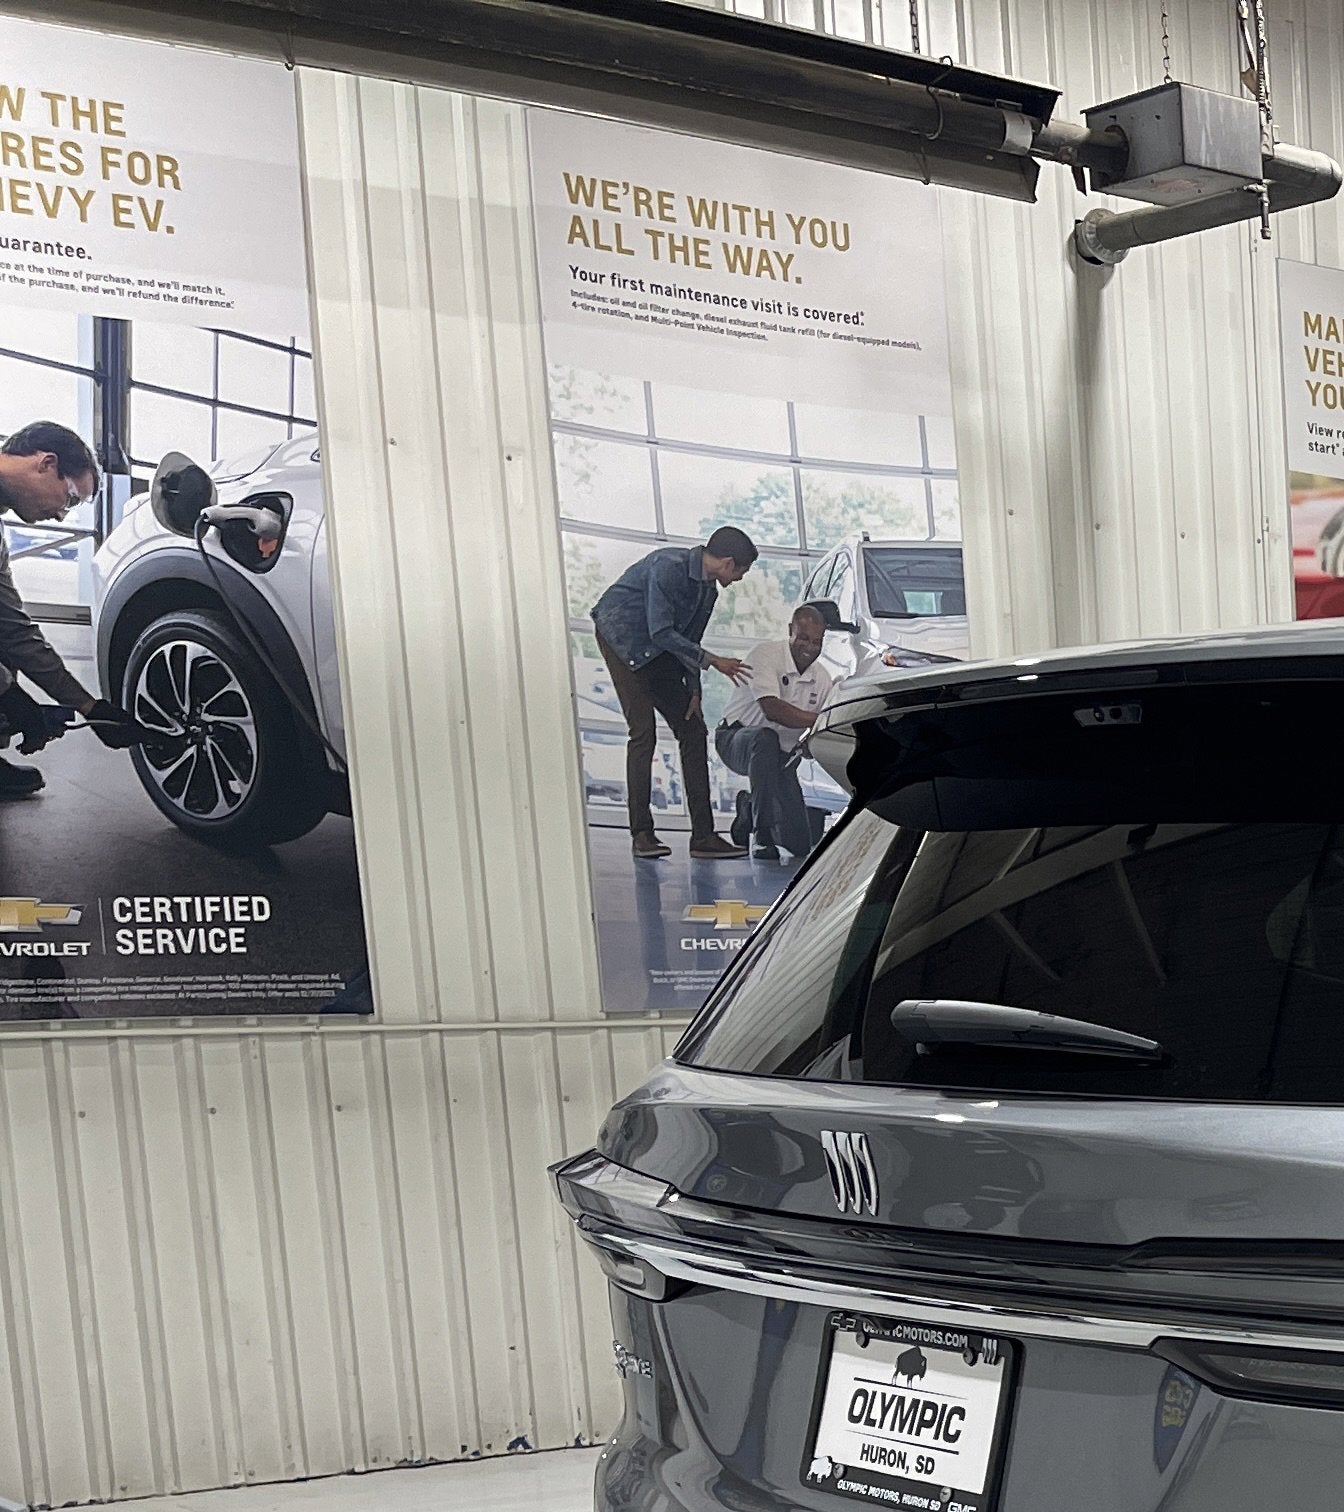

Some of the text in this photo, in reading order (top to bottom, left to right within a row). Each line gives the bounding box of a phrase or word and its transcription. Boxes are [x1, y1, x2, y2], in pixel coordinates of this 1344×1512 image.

[40, 91, 127, 138] THE
[0, 131, 182, 191] RES FOR
[0, 176, 175, 235] EVY EV.
[562, 172, 851, 252] WE'RE WITH YOU
[567, 214, 802, 285] ALL THE WAY.
[9, 275, 25, 284] the
[29, 278, 79, 293] purchase,
[82, 284, 99, 294] and
[128, 289, 160, 301] refund
[163, 294, 178, 303] the
[14, 263, 25, 272] at
[28, 264, 44, 274] the
[47, 267, 70, 278] time
[73, 270, 83, 279] of
[86, 273, 135, 287] purchase,
[138, 278, 154, 288] and
[183, 284, 212, 295] match
[568, 264, 606, 285] Your
[610, 272, 646, 293] first
[650, 283, 747, 311] maintenance
[751, 298, 783, 315] visit
[787, 302, 799, 317] is
[622, 300, 637, 309] and
[634, 314, 649, 322] and
[1306, 421, 1333, 438] View
[113, 896, 272, 924] CERTIFIED
[115, 927, 248, 956] SERVICE
[680, 937, 748, 951] CHEVR
[847, 1388, 967, 1444] OLYMPIC
[859, 1443, 935, 1475] HURON, SD
[837, 1479, 941, 1511] OLYMPIC MOTORS, HURON SD
